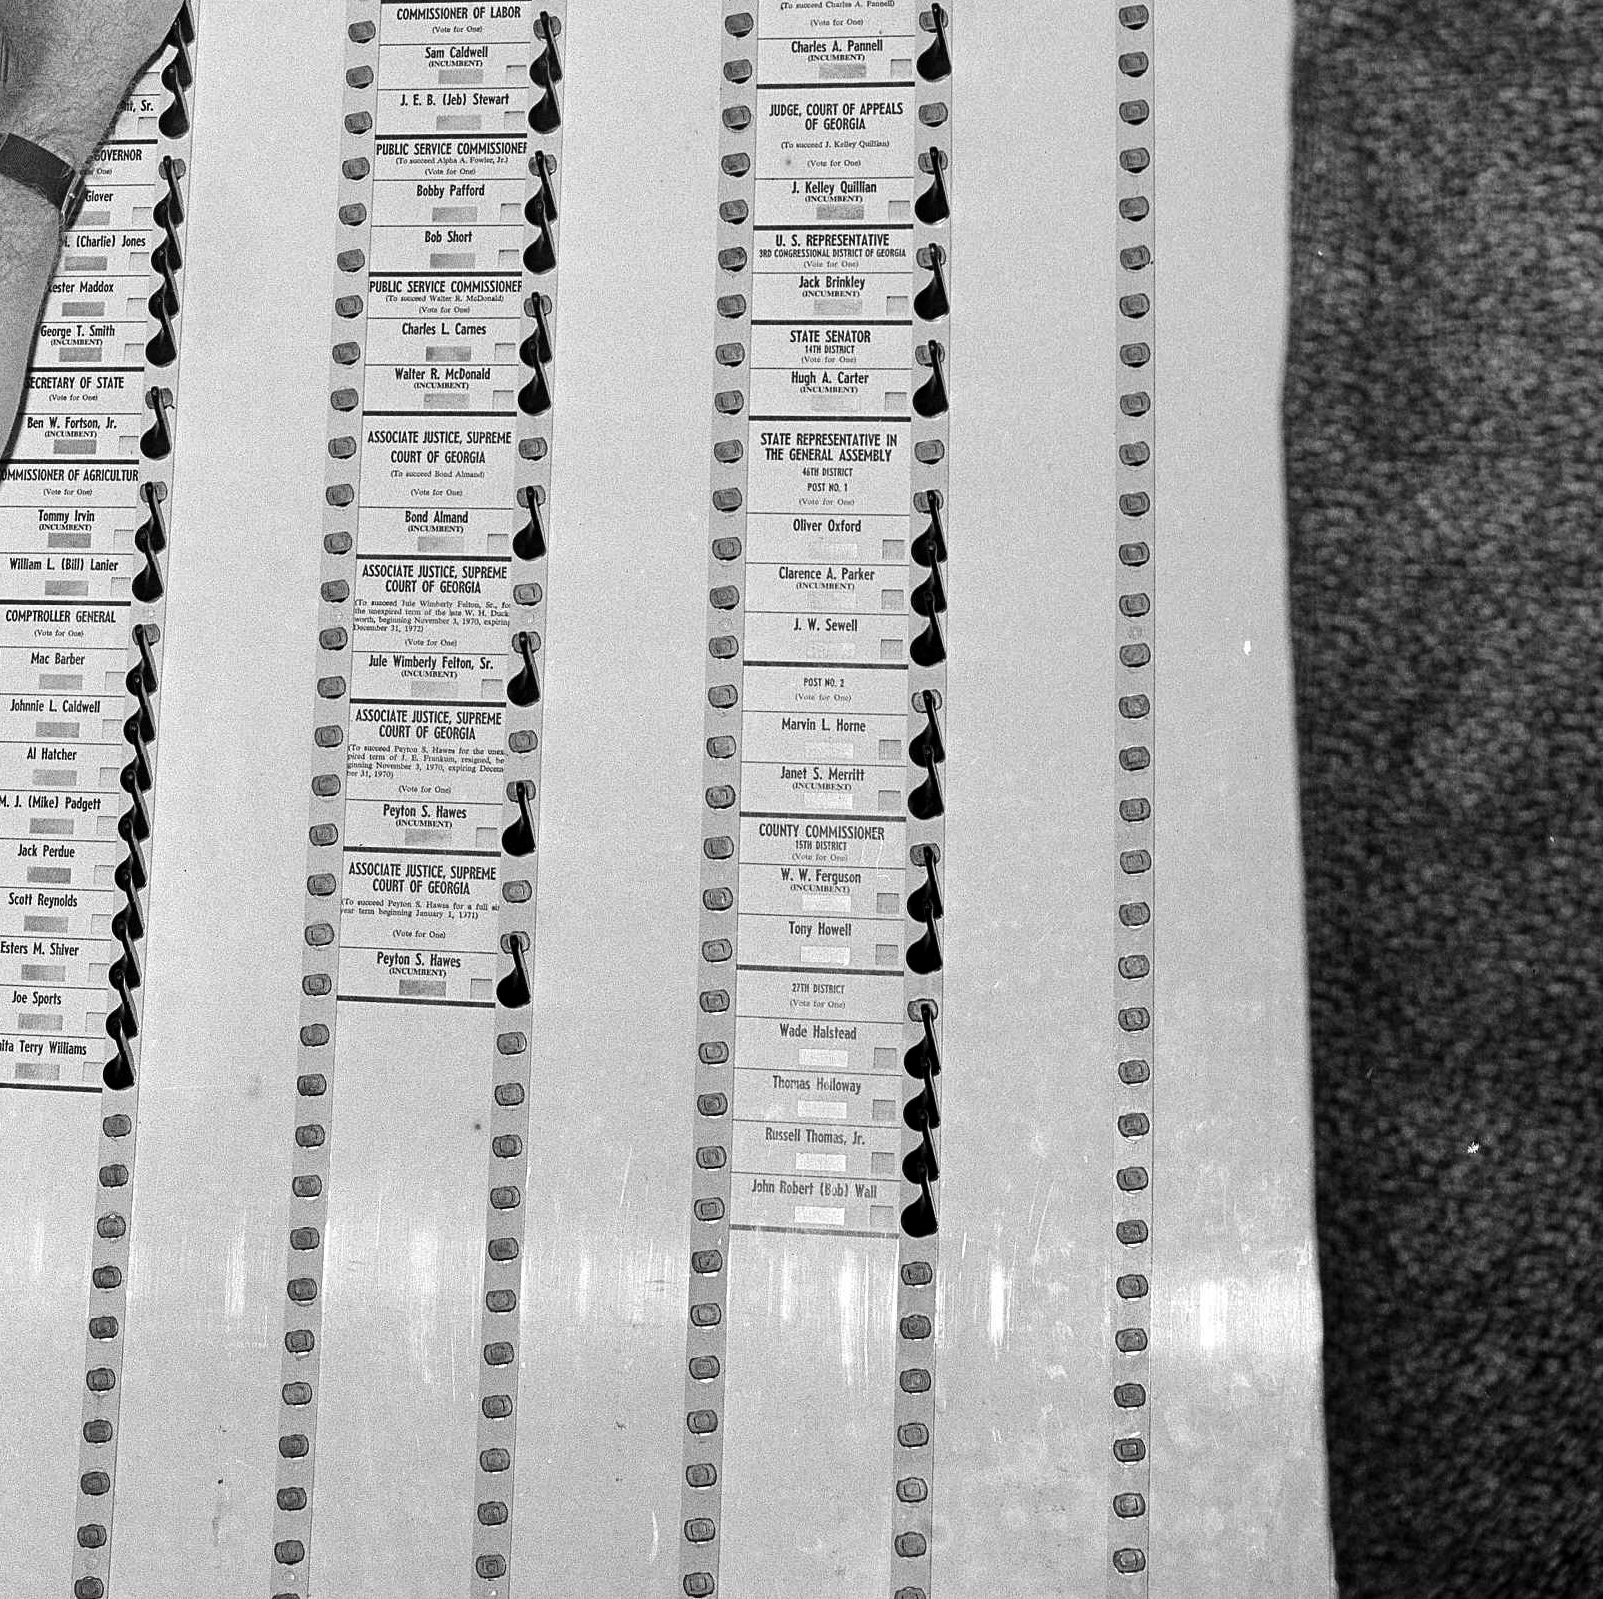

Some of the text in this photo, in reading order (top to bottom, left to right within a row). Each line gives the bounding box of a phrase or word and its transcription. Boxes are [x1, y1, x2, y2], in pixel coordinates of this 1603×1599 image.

[396, 5, 521, 20] COMMISSIONER OF LABOR
[424, 45, 488, 59] Sam Caldwell
[416, 183, 485, 199] Bobby Pafford
[424, 230, 472, 242] Bob Short
[798, 275, 865, 290] Jack Brinkley
[40, 324, 115, 338] George T. Smith
[789, 329, 870, 343] STATE SENATOR
[805, 344, 855, 354] 14TH DISTRICT
[27, 416, 117, 429] Ben W. Fortson, Jr.
[44, 430, 97, 438] (INCUMBENT)
[367, 430, 511, 444] ASSOCIATE JUSTICE, SUPREME
[760, 432, 897, 446] STATE REPRESENTATIVE IN
[390, 450, 485, 463] COURT OF GEORGIA
[38, 509, 95, 523] Tommy Irvin
[404, 510, 468, 523] Bond Almand
[793, 518, 861, 532] Oliver Oxford
[9, 557, 118, 571] William L. (Bill) Lanier
[5, 609, 116, 623] COMPTROLLER GENERAL
[30, 651, 85, 665] Mac Barber
[9, 698, 100, 713] Johnnie L. Caldwell
[26, 746, 77, 760] Al Hatcher
[758, 823, 884, 840] COUNTY COMMISSIONER
[17, 843, 75, 858] Jack Perdue
[8, 891, 77, 909] Scott Reynolds
[788, 920, 851, 937] Tony Howell
[11, 990, 61, 1007] Joe Sports
[779, 1022, 856, 1040] Wade Halstead
[19, 1039, 43, 1056] Terry
[49, 1040, 86, 1055] Williams
